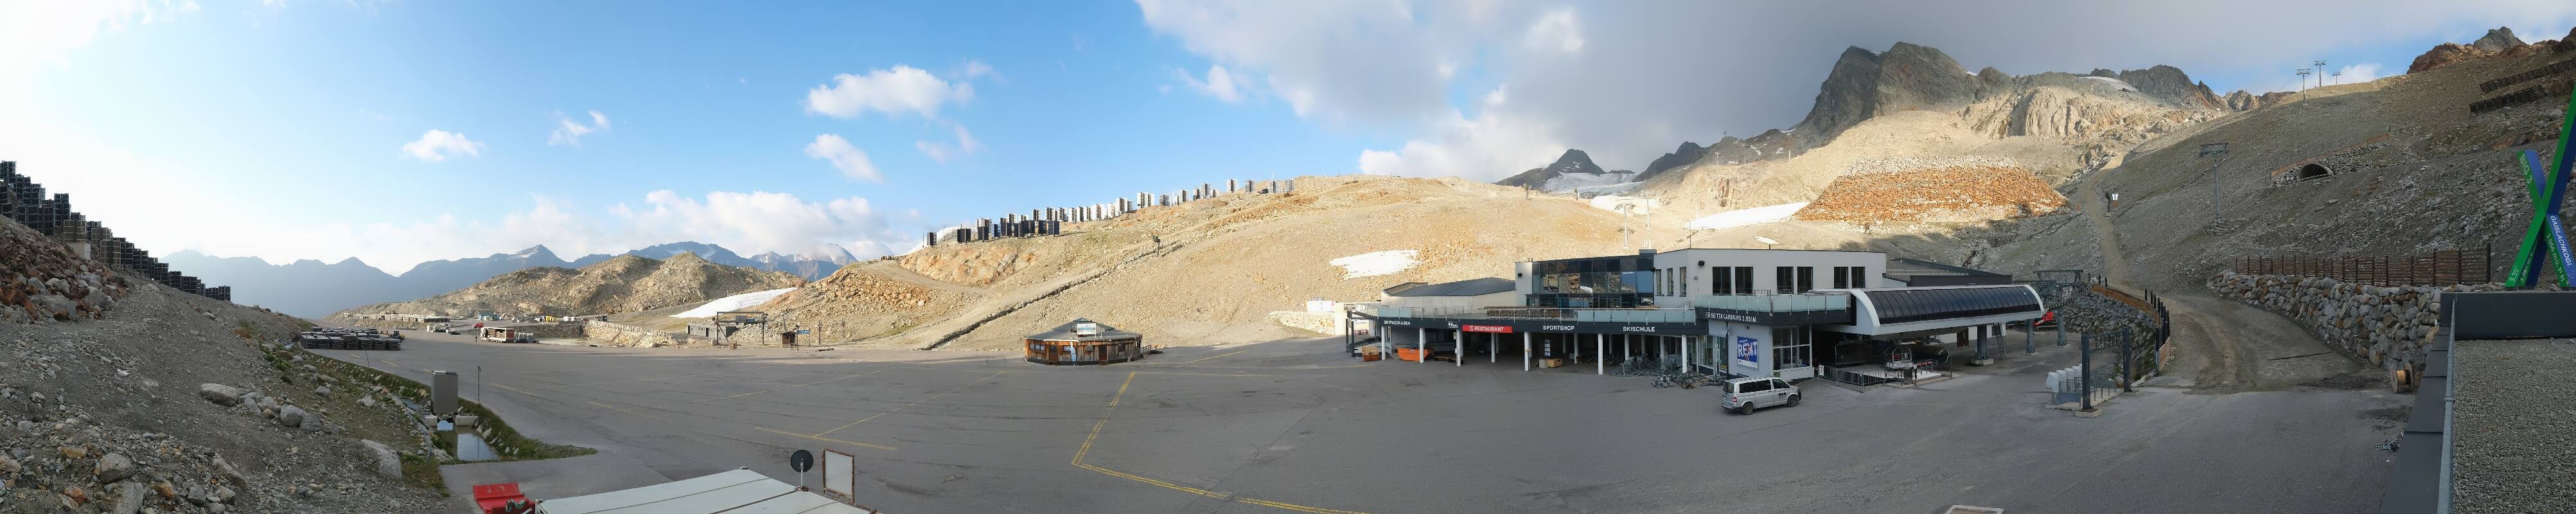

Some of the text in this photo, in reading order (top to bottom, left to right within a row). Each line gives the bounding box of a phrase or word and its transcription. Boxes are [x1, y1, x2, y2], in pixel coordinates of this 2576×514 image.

[2519, 154, 2532, 184] BIG 3
[2550, 215, 2572, 267] GAISLACHKOGL
[1738, 342, 1757, 357] RENT
